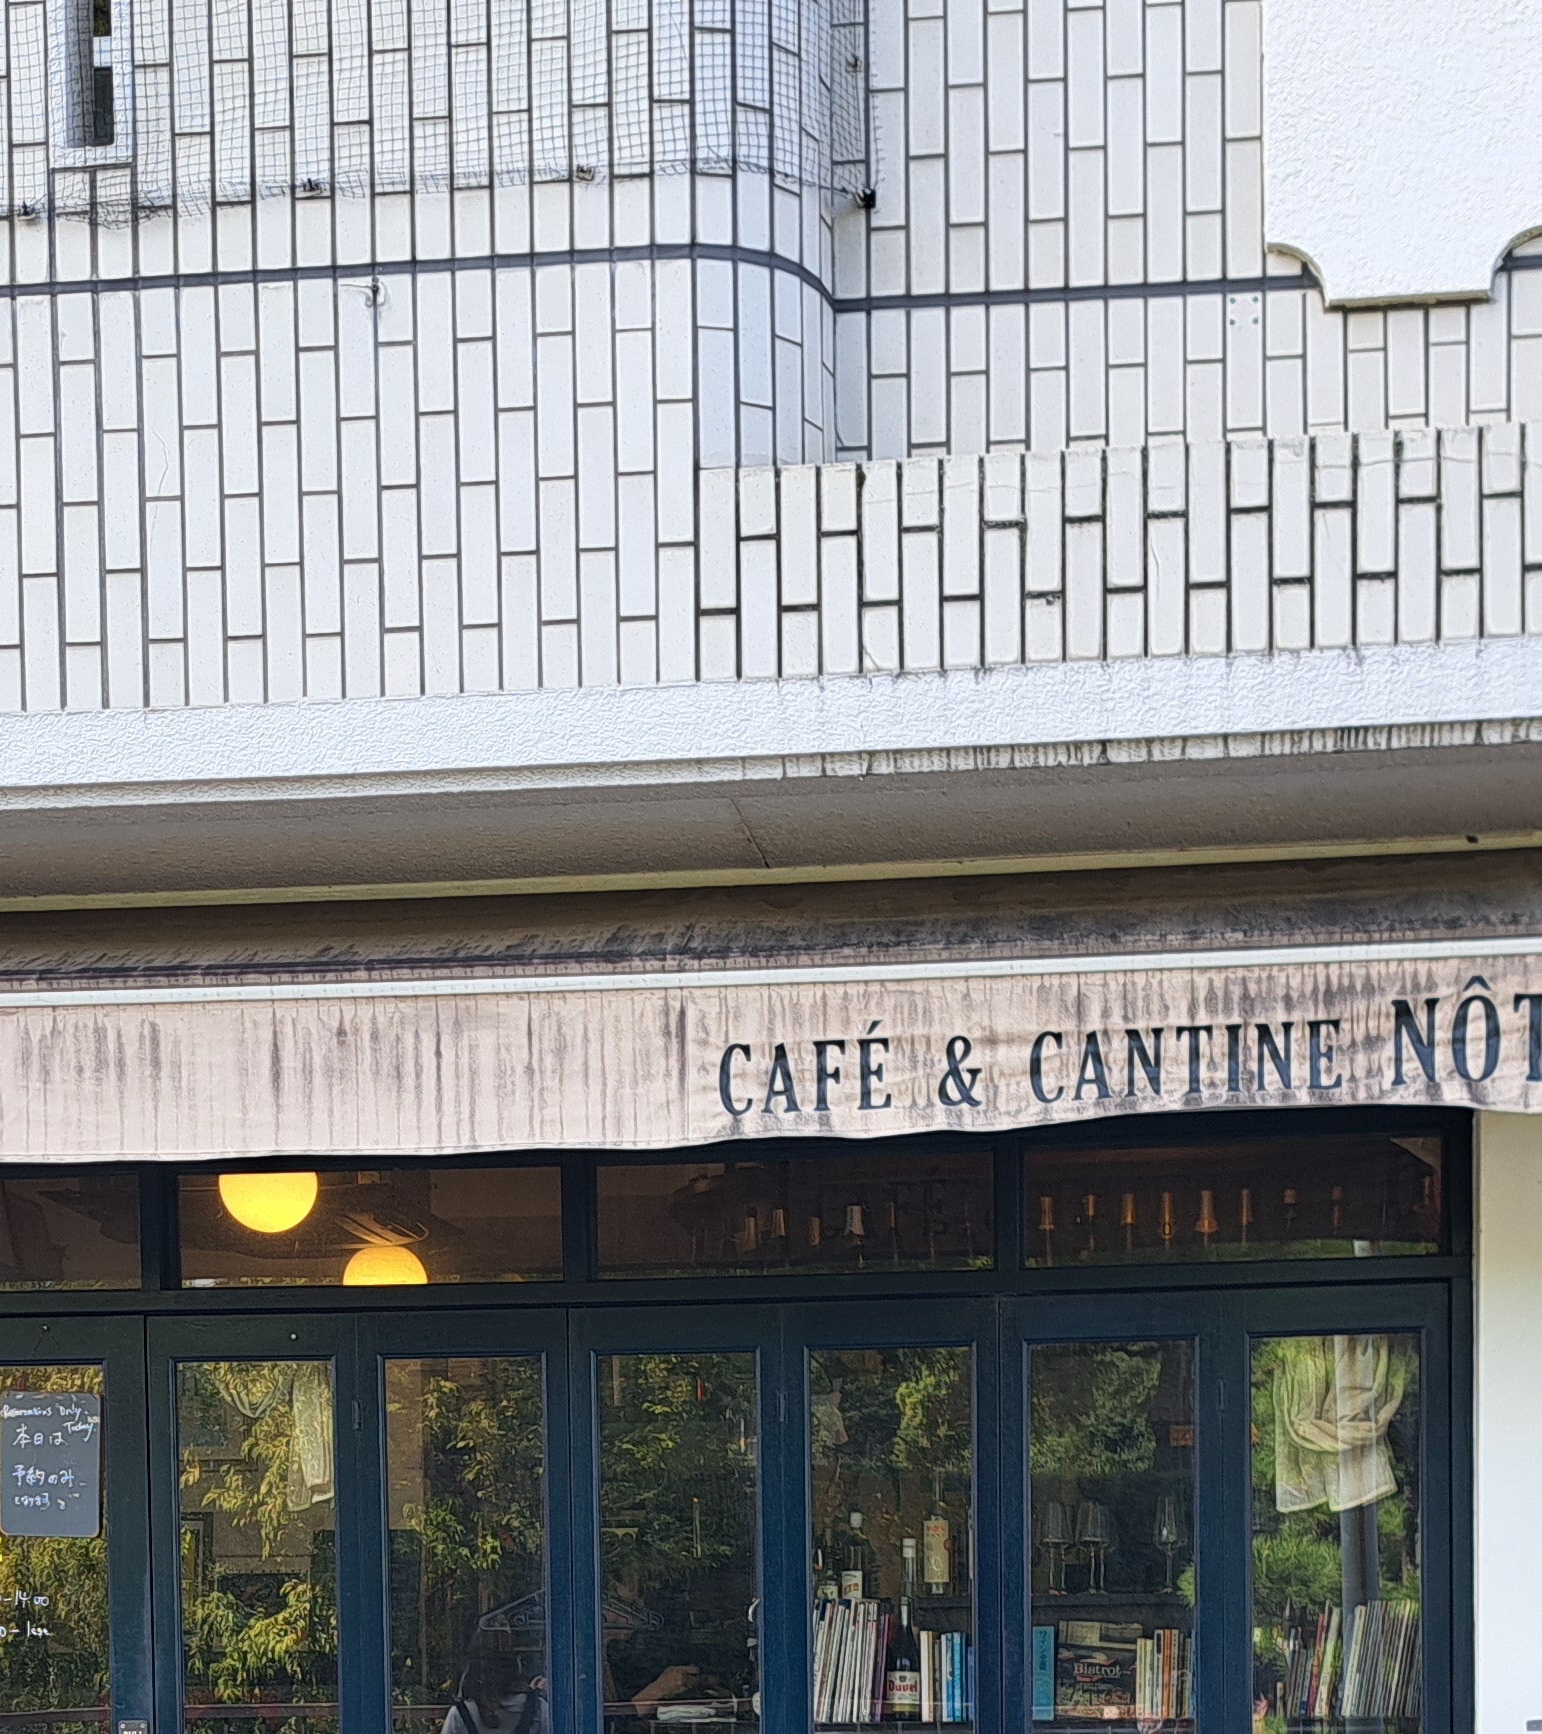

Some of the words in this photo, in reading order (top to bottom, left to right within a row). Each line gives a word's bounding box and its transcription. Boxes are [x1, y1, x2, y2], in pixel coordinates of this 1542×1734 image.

[718, 1019, 893, 1117] CAFÉ
[937, 1034, 983, 1108] &
[1029, 1019, 1343, 1103] CANTINE
[12, 1422, 68, 1449] 本日は
[12, 1464, 76, 1488] 予約のみ
[888, 1680, 918, 1694] Duvel
